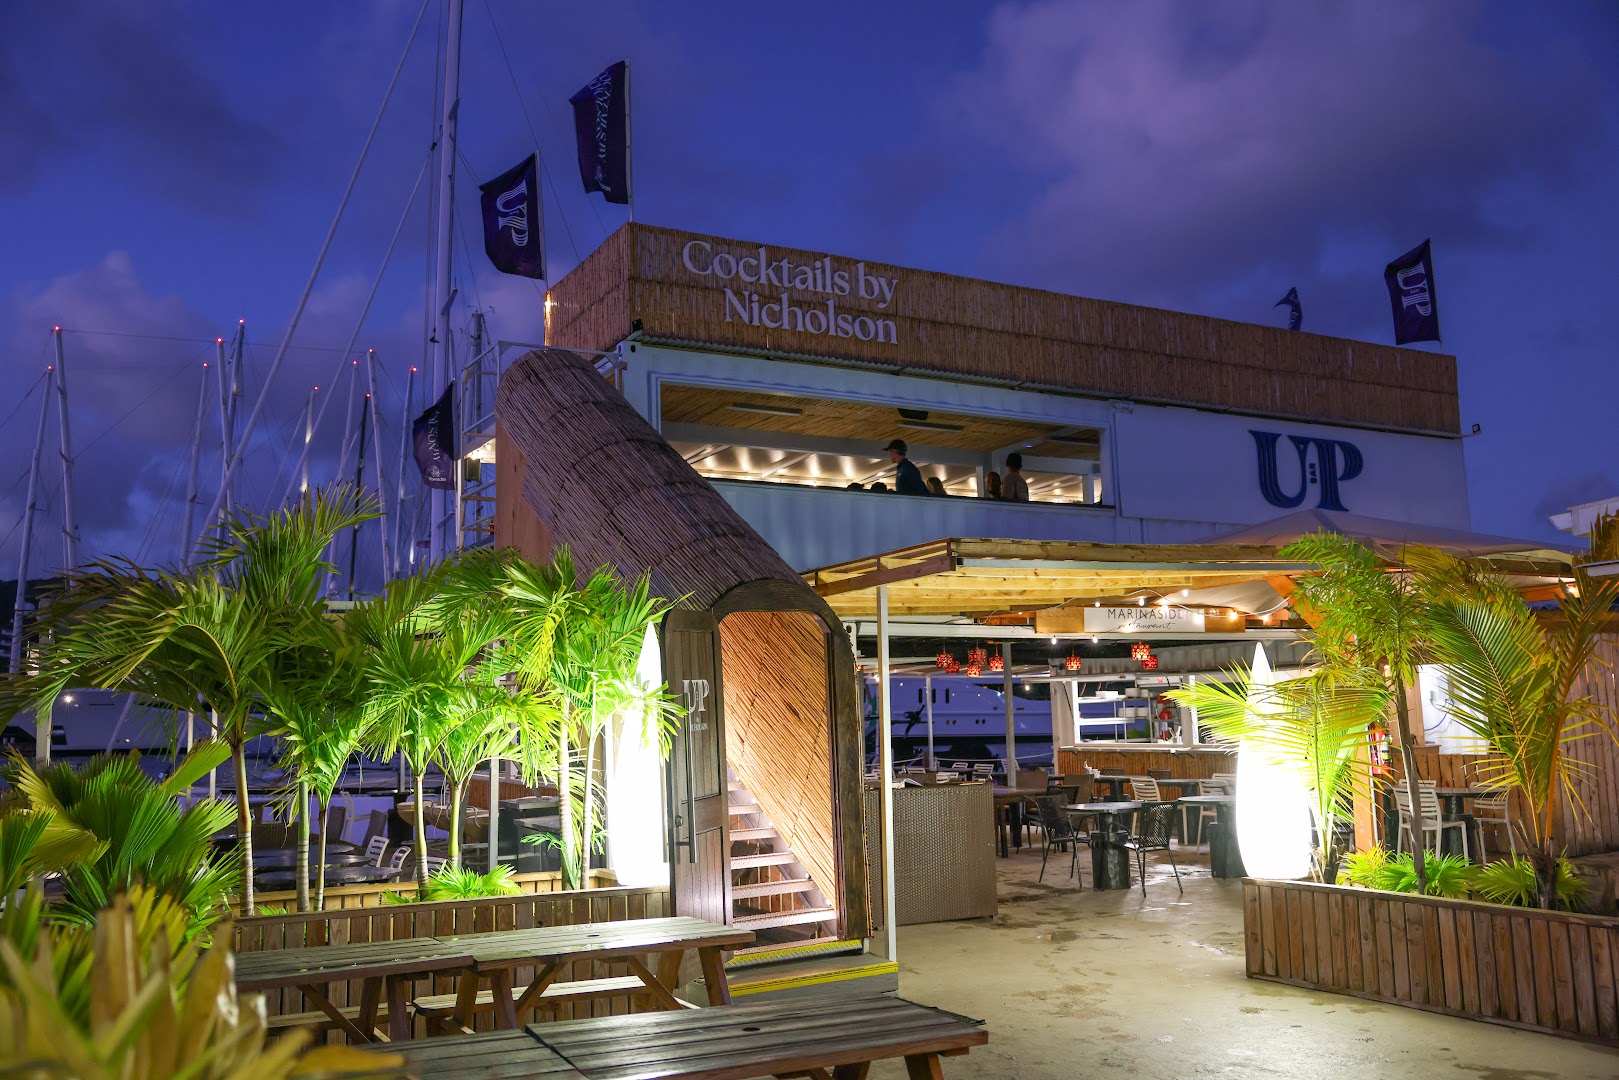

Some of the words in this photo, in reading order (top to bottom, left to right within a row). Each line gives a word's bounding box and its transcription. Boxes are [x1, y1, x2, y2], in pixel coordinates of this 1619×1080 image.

[496, 179, 529, 247] UP
[682, 240, 849, 296] Cocktails
[857, 262, 898, 309] by
[1396, 261, 1432, 317] UP
[724, 288, 898, 345] Nicholson
[1248, 429, 1364, 512] UP
[1309, 463, 1318, 484] BAR
[682, 679, 710, 713] UP
